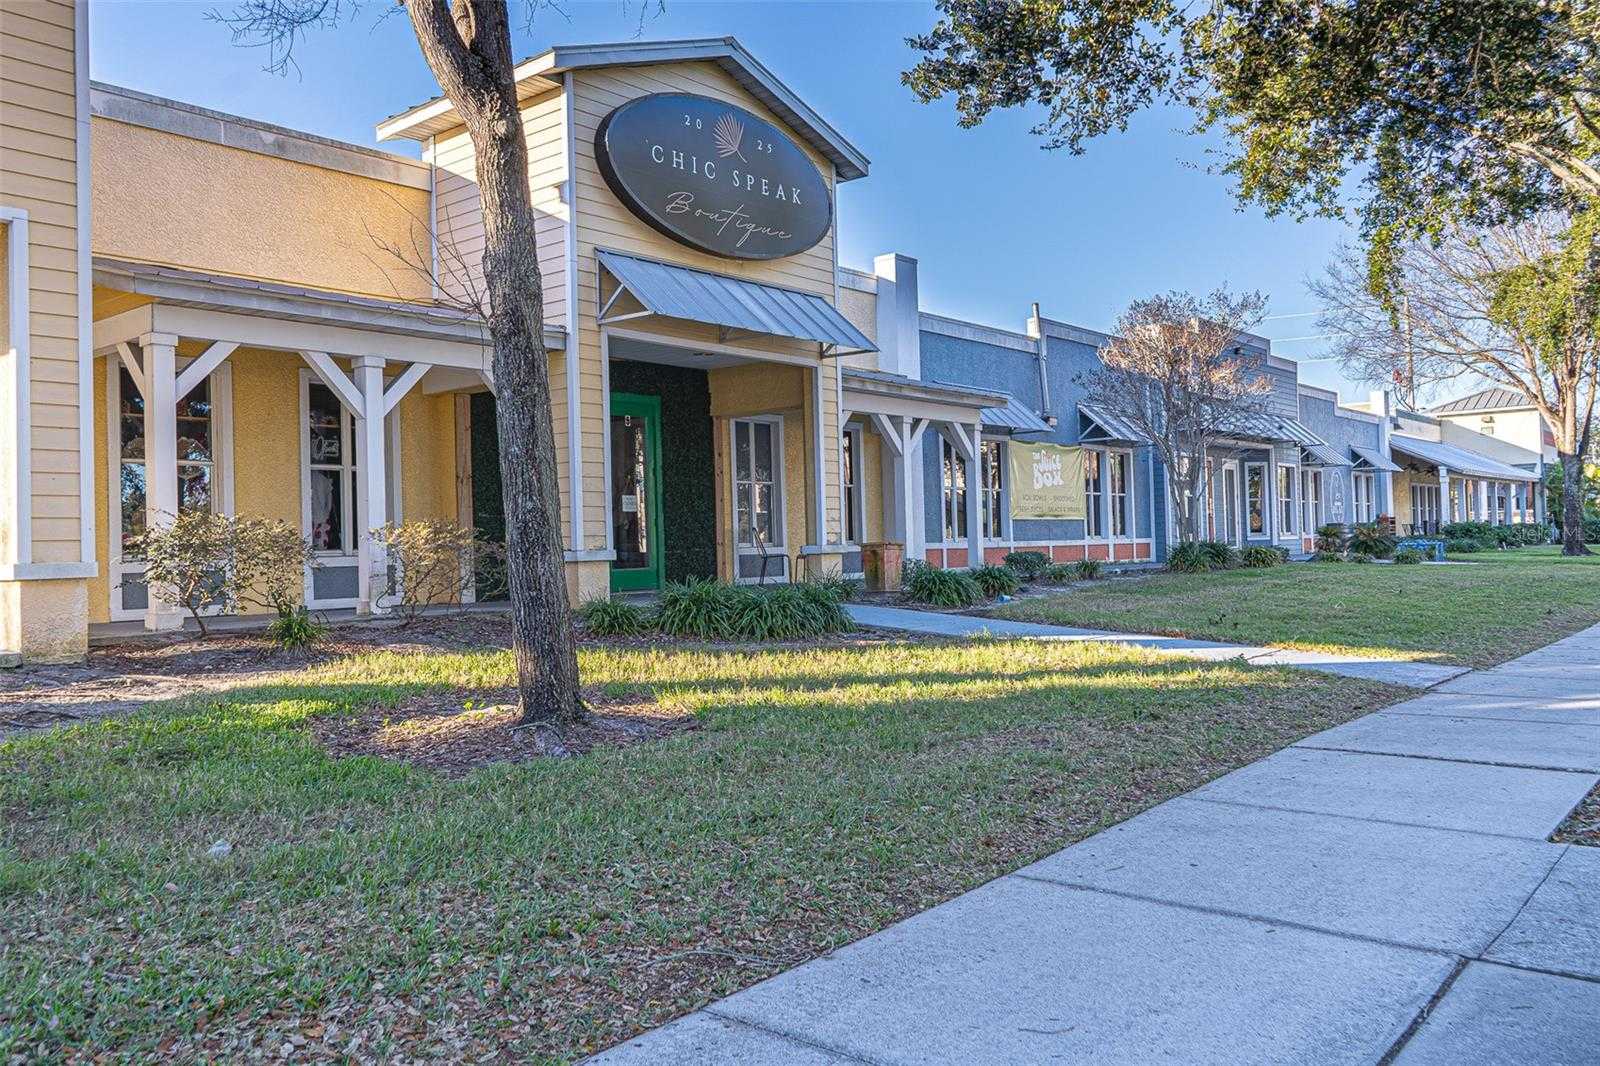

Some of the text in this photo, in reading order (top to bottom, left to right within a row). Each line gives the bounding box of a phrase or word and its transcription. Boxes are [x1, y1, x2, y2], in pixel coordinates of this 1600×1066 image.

[684, 114, 773, 154] 20 25
[651, 144, 801, 205] CHIC SPEAK
[665, 191, 792, 248] Boutique
